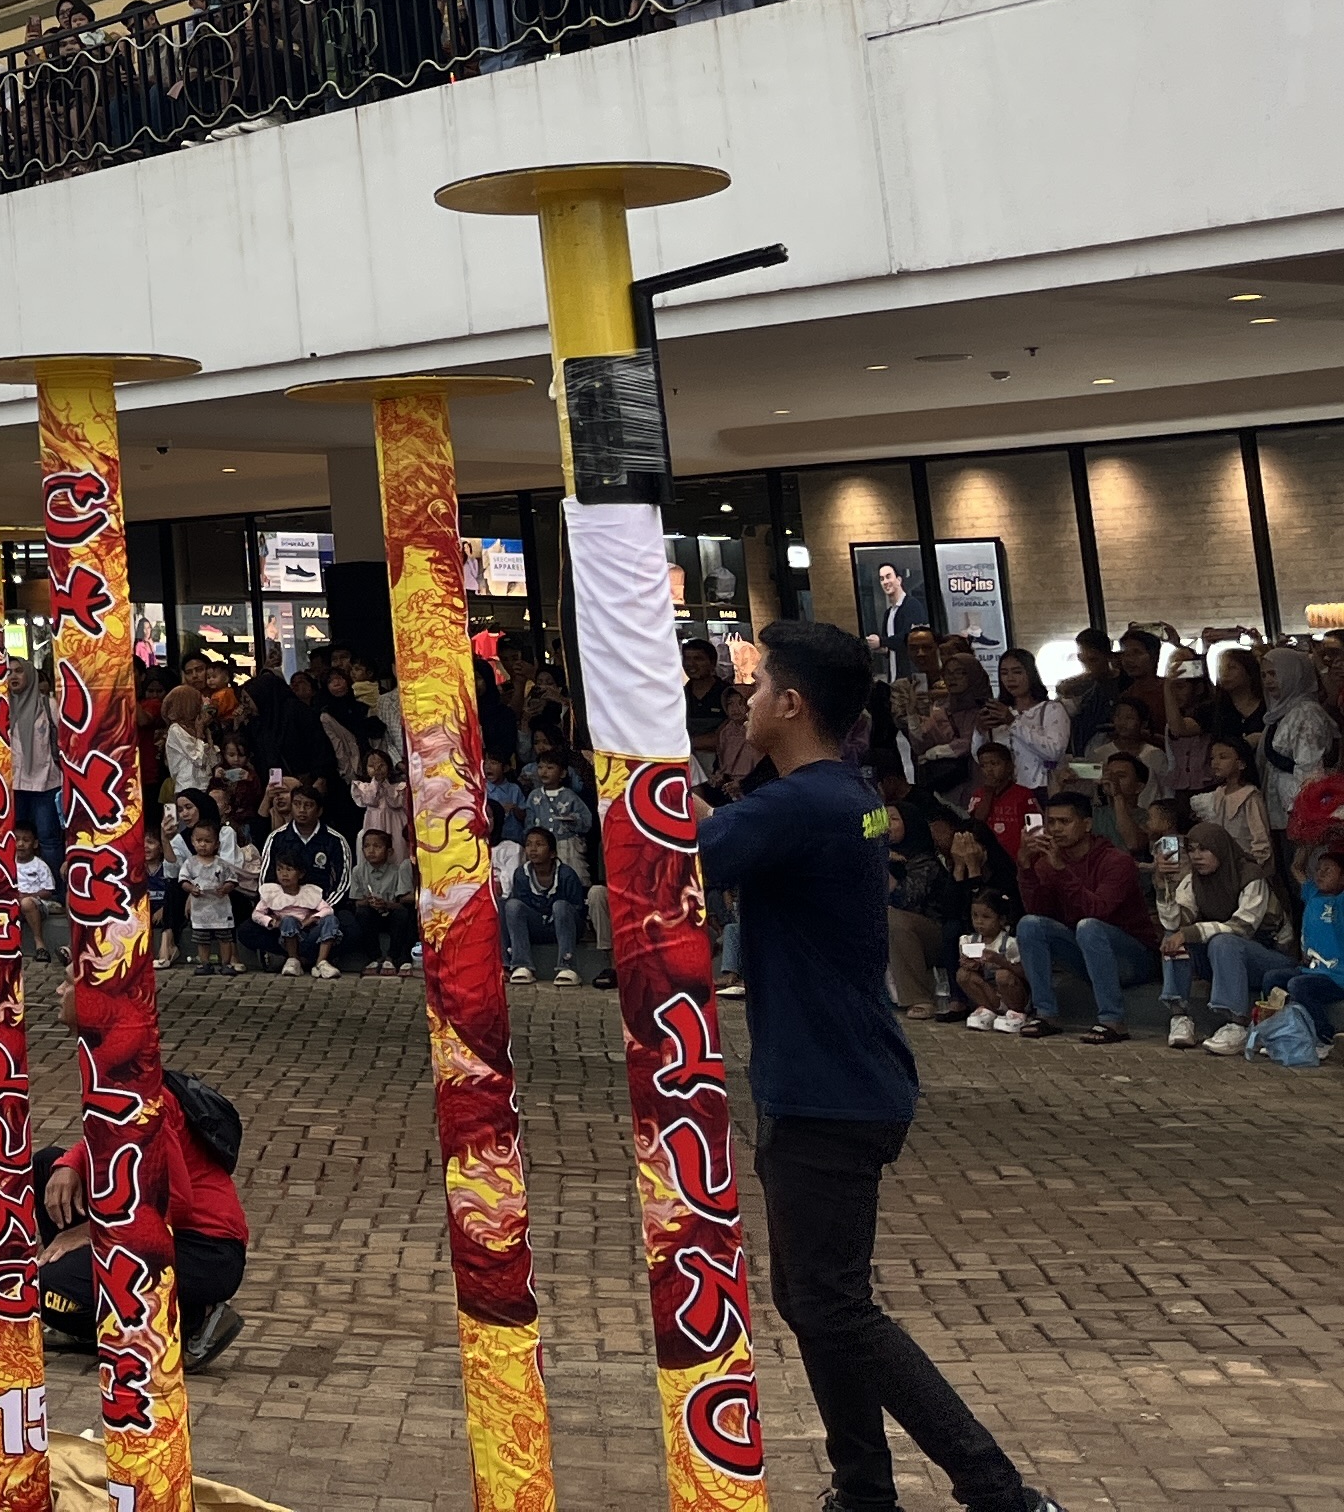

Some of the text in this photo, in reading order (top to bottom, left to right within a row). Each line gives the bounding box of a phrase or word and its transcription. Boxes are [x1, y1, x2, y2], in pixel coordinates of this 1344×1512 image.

[949, 578, 994, 594] Slip-ins
[201, 604, 233, 617] RUN
[300, 607, 330, 619] WAL
